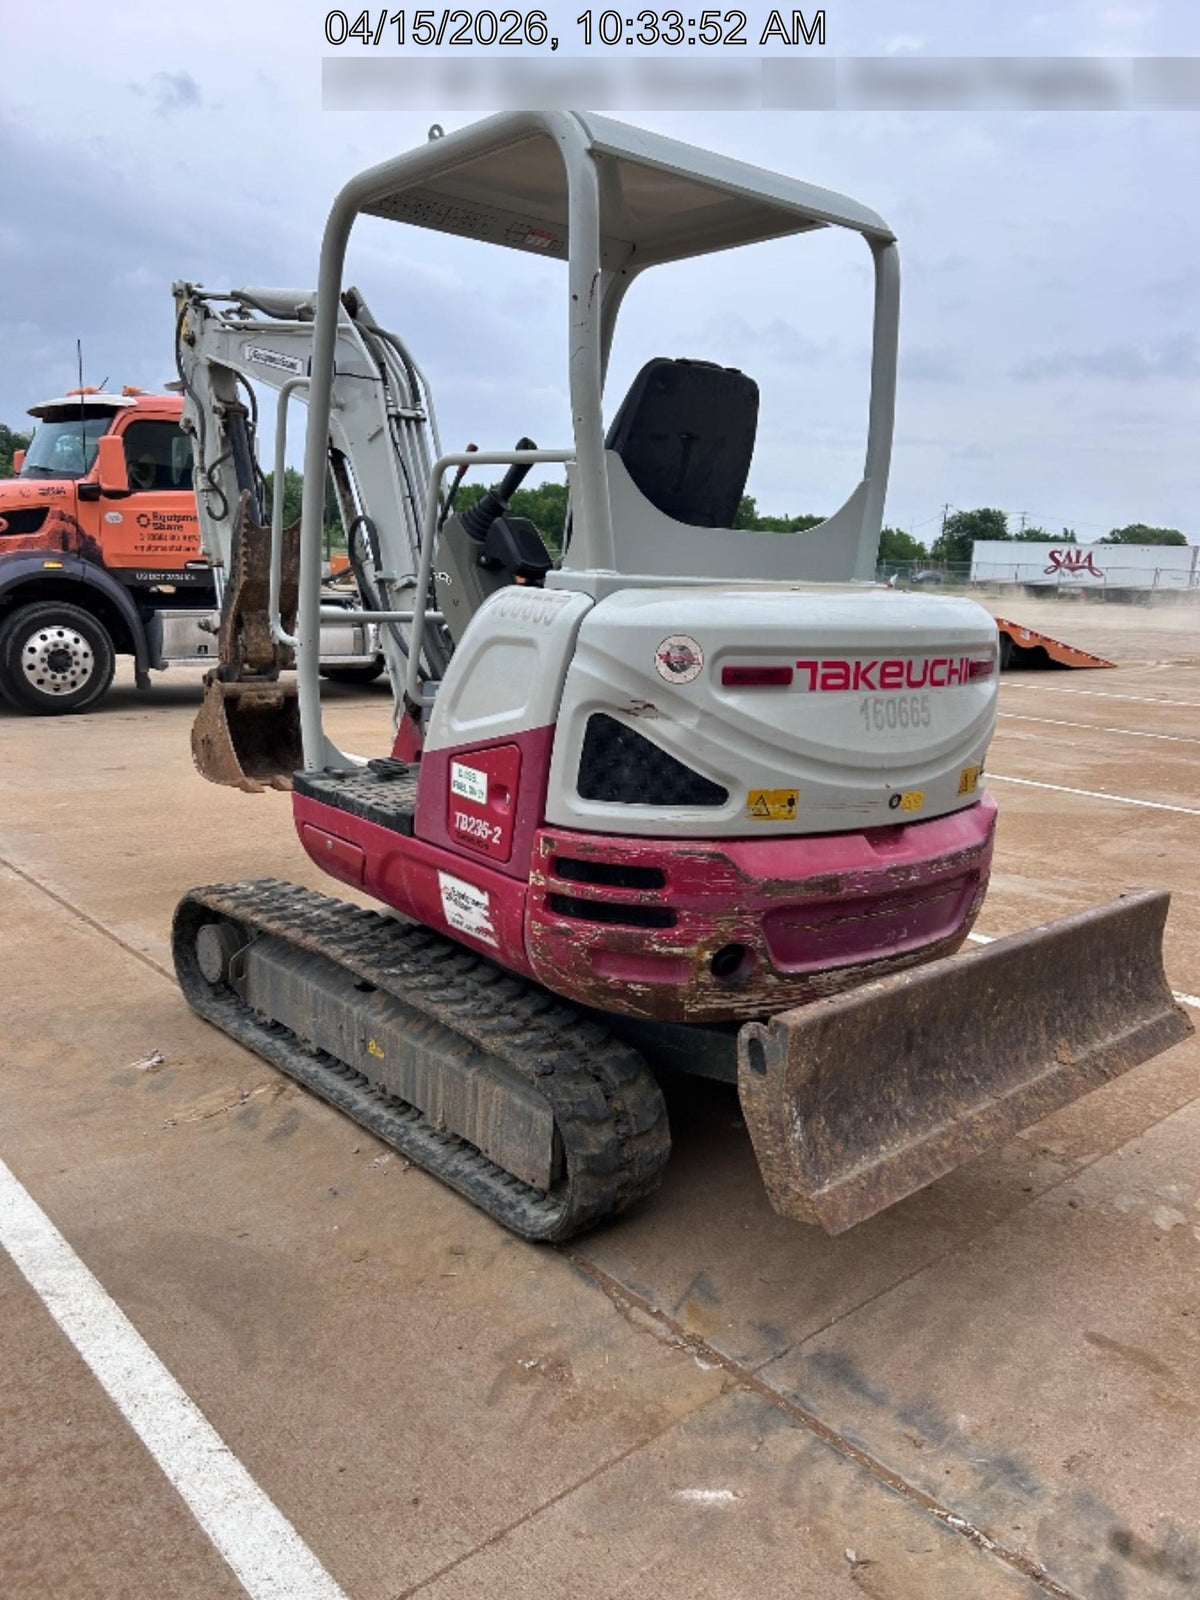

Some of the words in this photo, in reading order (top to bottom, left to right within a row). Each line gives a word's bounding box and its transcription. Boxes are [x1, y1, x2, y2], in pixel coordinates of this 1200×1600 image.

[1046, 549, 1099, 573] SAIA
[860, 695, 931, 732] 160665
[454, 811, 503, 845] TB235-2
